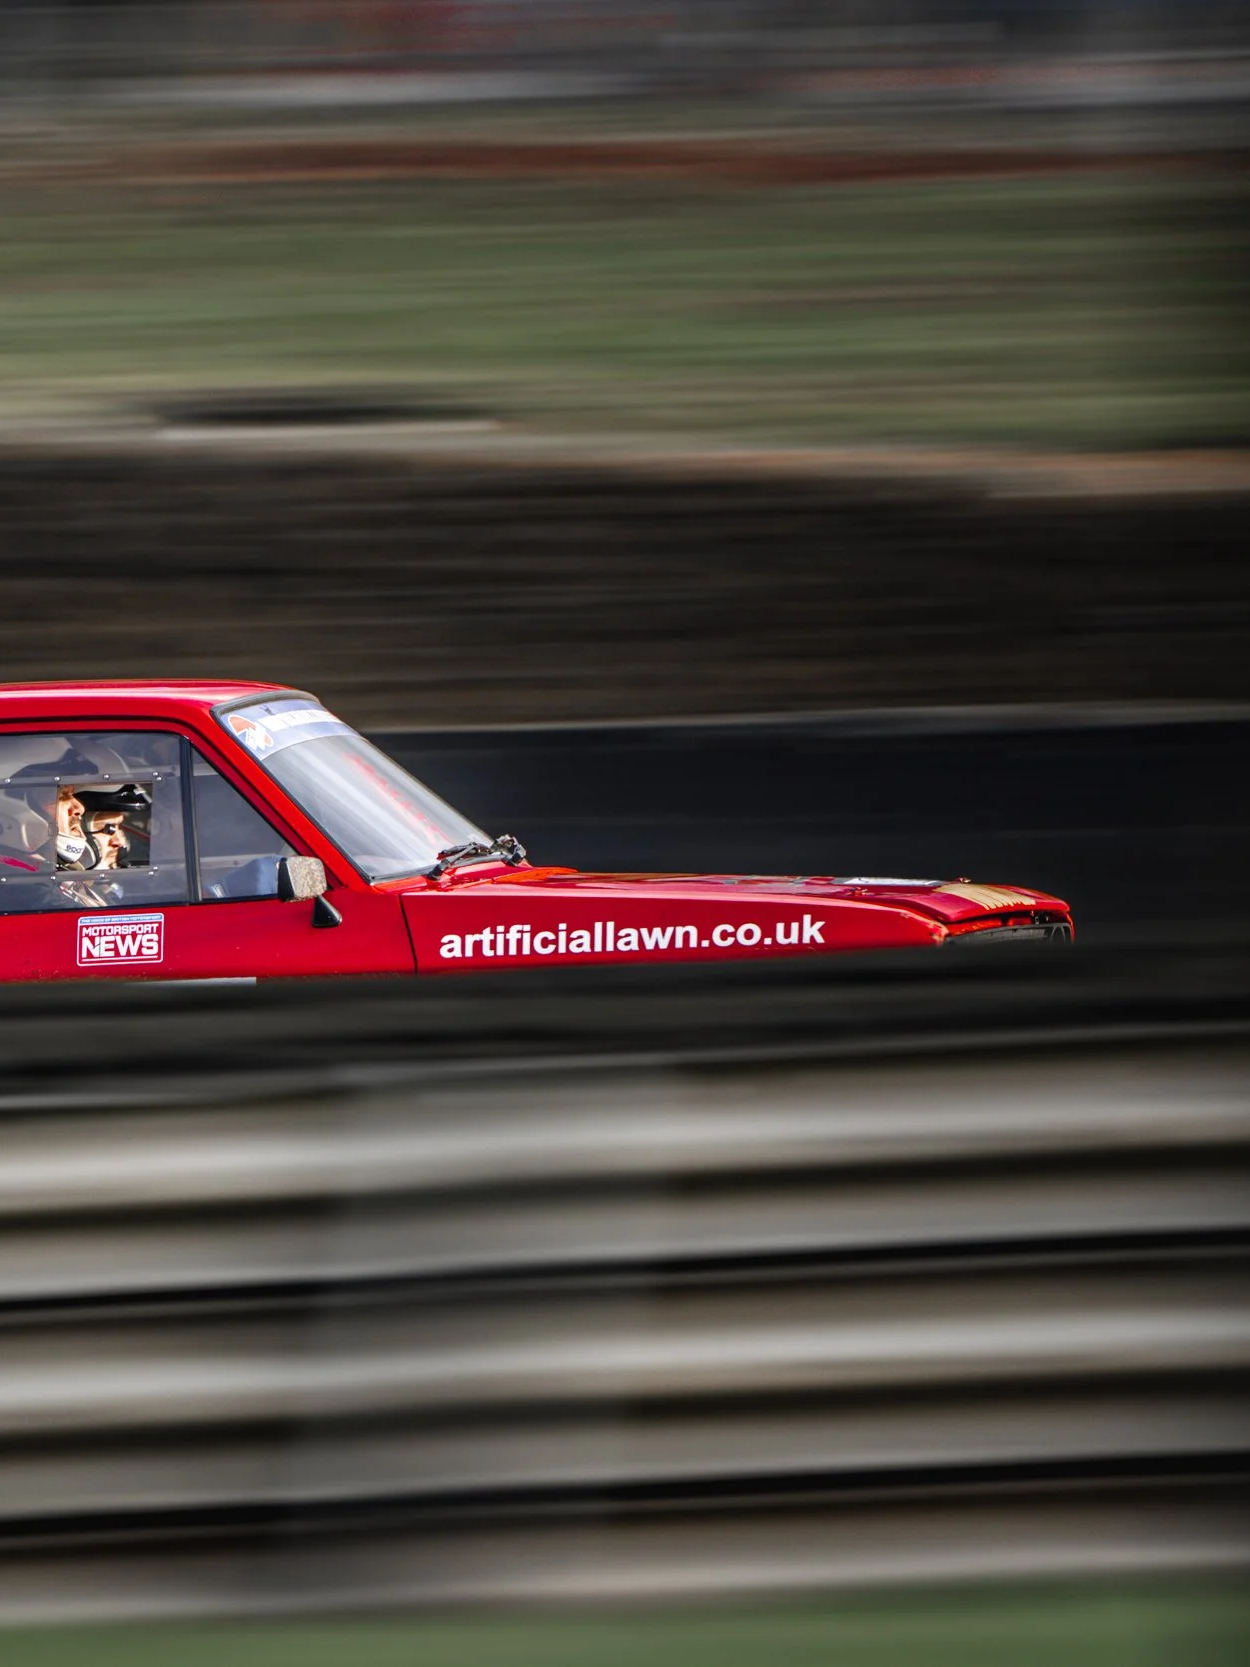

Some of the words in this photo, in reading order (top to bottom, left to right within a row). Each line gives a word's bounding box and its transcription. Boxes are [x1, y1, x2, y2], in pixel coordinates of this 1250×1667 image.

[82, 923, 159, 937] MOTORSPORT
[439, 914, 826, 958] artificiallawn.co.uk
[81, 933, 159, 958] NEWS
